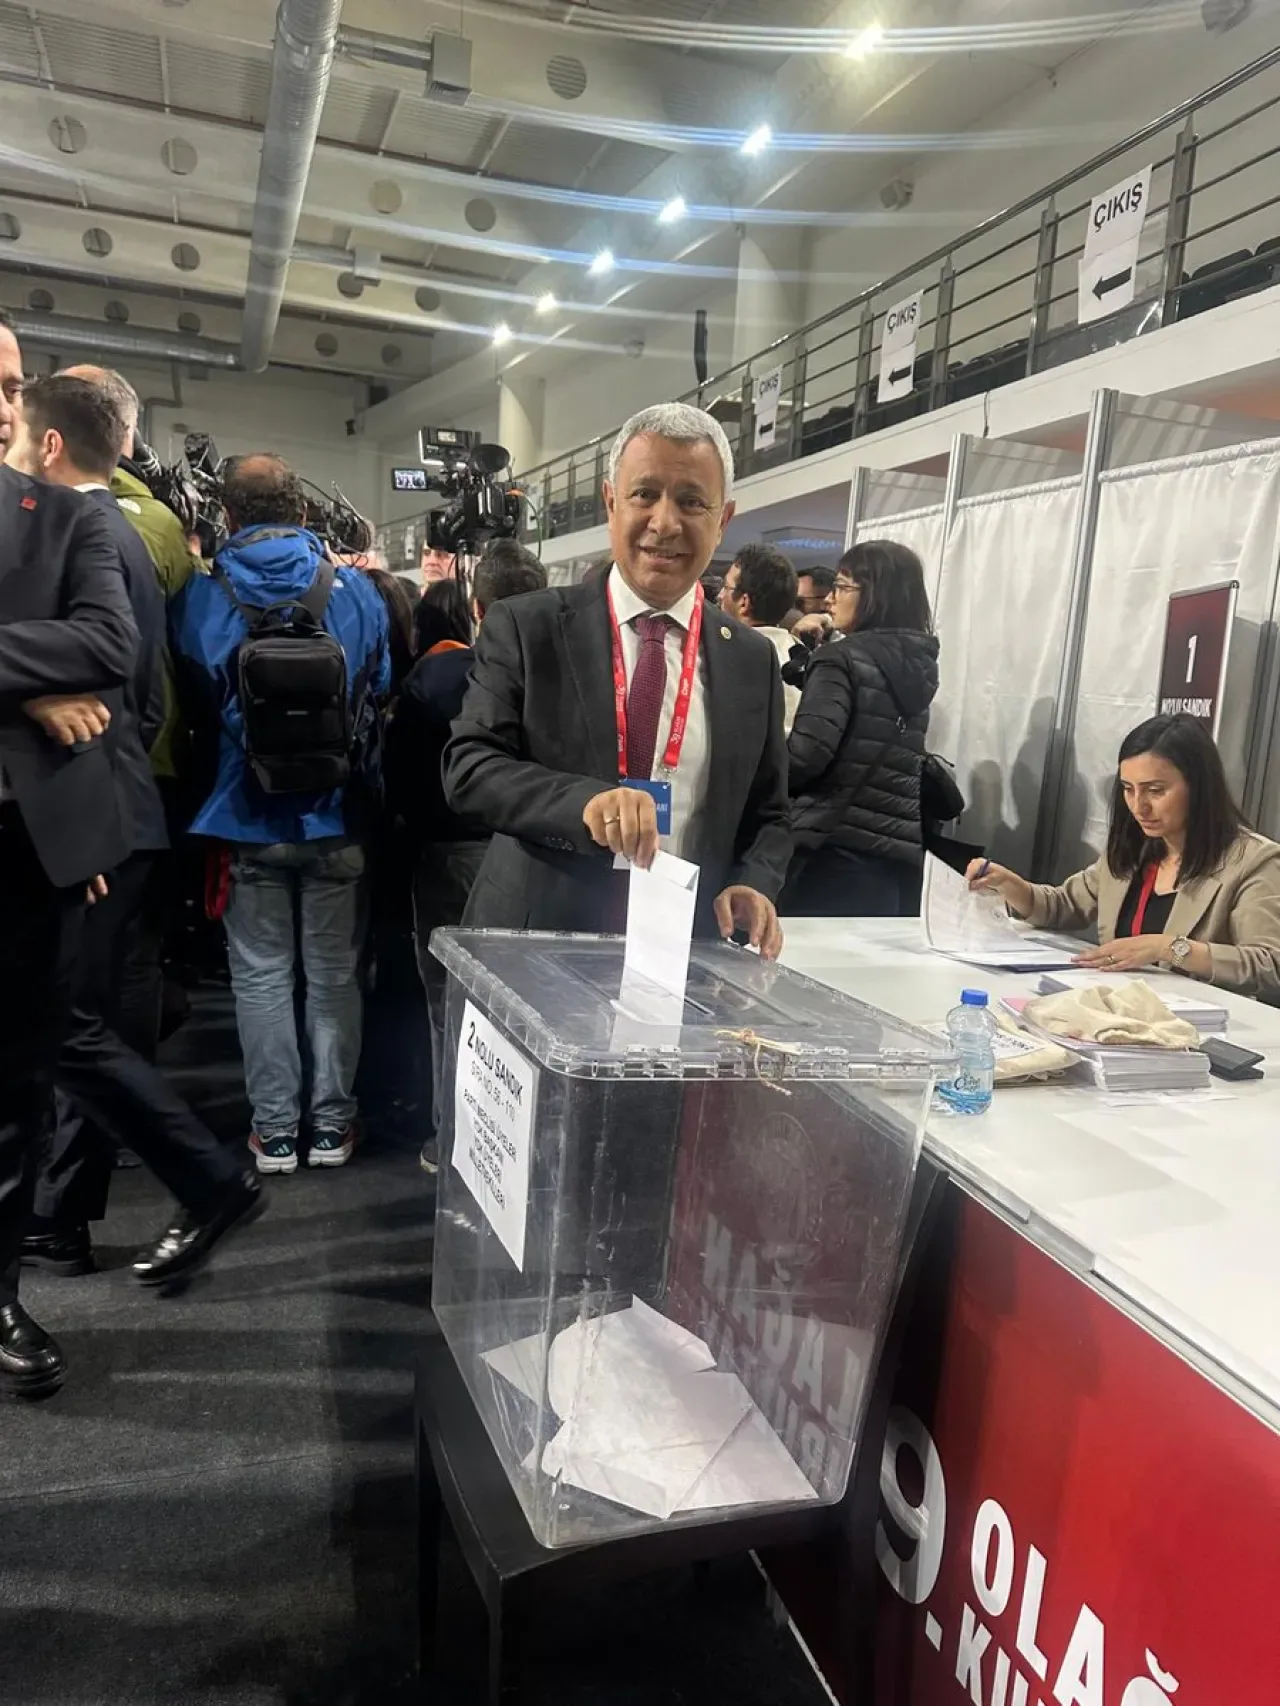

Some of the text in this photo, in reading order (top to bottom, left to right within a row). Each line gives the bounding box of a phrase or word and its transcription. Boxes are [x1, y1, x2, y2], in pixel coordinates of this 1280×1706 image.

[1094, 182, 1143, 233] ÇIKIŞ
[887, 301, 917, 334] ÇIKIŞ
[1185, 634, 1198, 683] 1
[467, 1021, 523, 1107] 2 NOLU SANDIK
